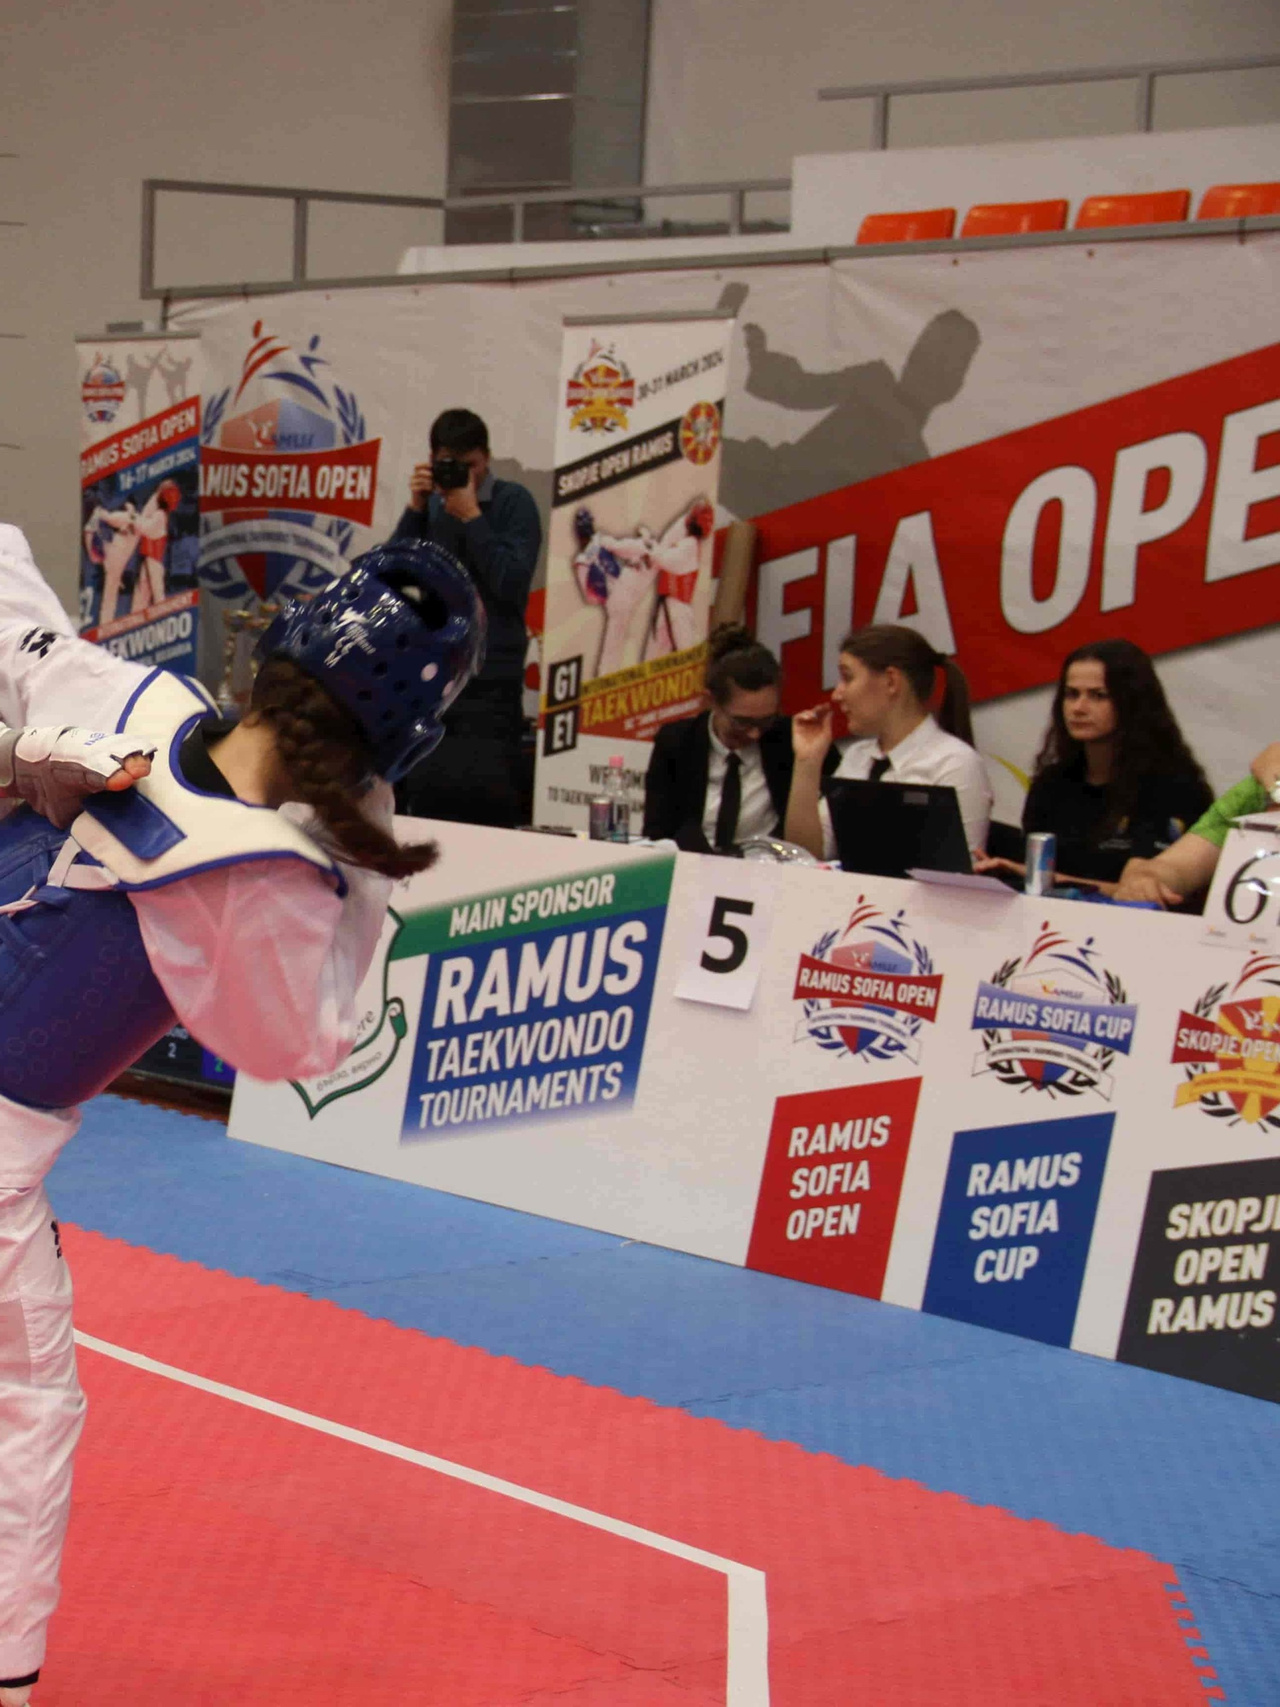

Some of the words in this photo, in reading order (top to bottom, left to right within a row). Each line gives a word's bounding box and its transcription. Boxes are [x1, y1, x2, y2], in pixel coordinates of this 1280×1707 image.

[121, 425, 159, 459] SOFIA
[160, 407, 197, 438] OPEN
[252, 464, 311, 498] SOFIA
[315, 465, 373, 500] OPEN
[559, 461, 600, 496] SKOPJE
[600, 448, 631, 479] OPEN
[631, 431, 674, 468] RAMUS
[756, 510, 957, 692] FIA
[554, 661, 578, 700] G1
[552, 709, 575, 749] E1
[449, 900, 506, 938] MAIN
[509, 873, 616, 926] SPONSOR
[1225, 850, 1279, 925] 6
[700, 896, 755, 974] 5
[432, 920, 648, 1029] RAMUS
[799, 967, 851, 995] RAMUS
[852, 975, 895, 1002] SOFIA
[897, 983, 937, 1009] OPEN
[976, 996, 1038, 1026] RAMUS
[1040, 1006, 1091, 1037] SOFIA
[1094, 1014, 1133, 1041] CUP
[168, 1043, 177, 1059] 2
[426, 1005, 634, 1083] TAEKWONDO
[1177, 1027, 1241, 1056] SKOPJE
[418, 1062, 623, 1130] TOURNAMENTS
[787, 1115, 891, 1158] RAMUS
[789, 1160, 871, 1199] SOFIA
[966, 1152, 1082, 1197] RAMUS
[786, 1203, 861, 1241] OPEN
[968, 1199, 1059, 1240] SOFIA
[974, 1246, 1039, 1284] CUP
[1173, 1243, 1270, 1286] OPEN
[1146, 1290, 1277, 1334] RAMUS
